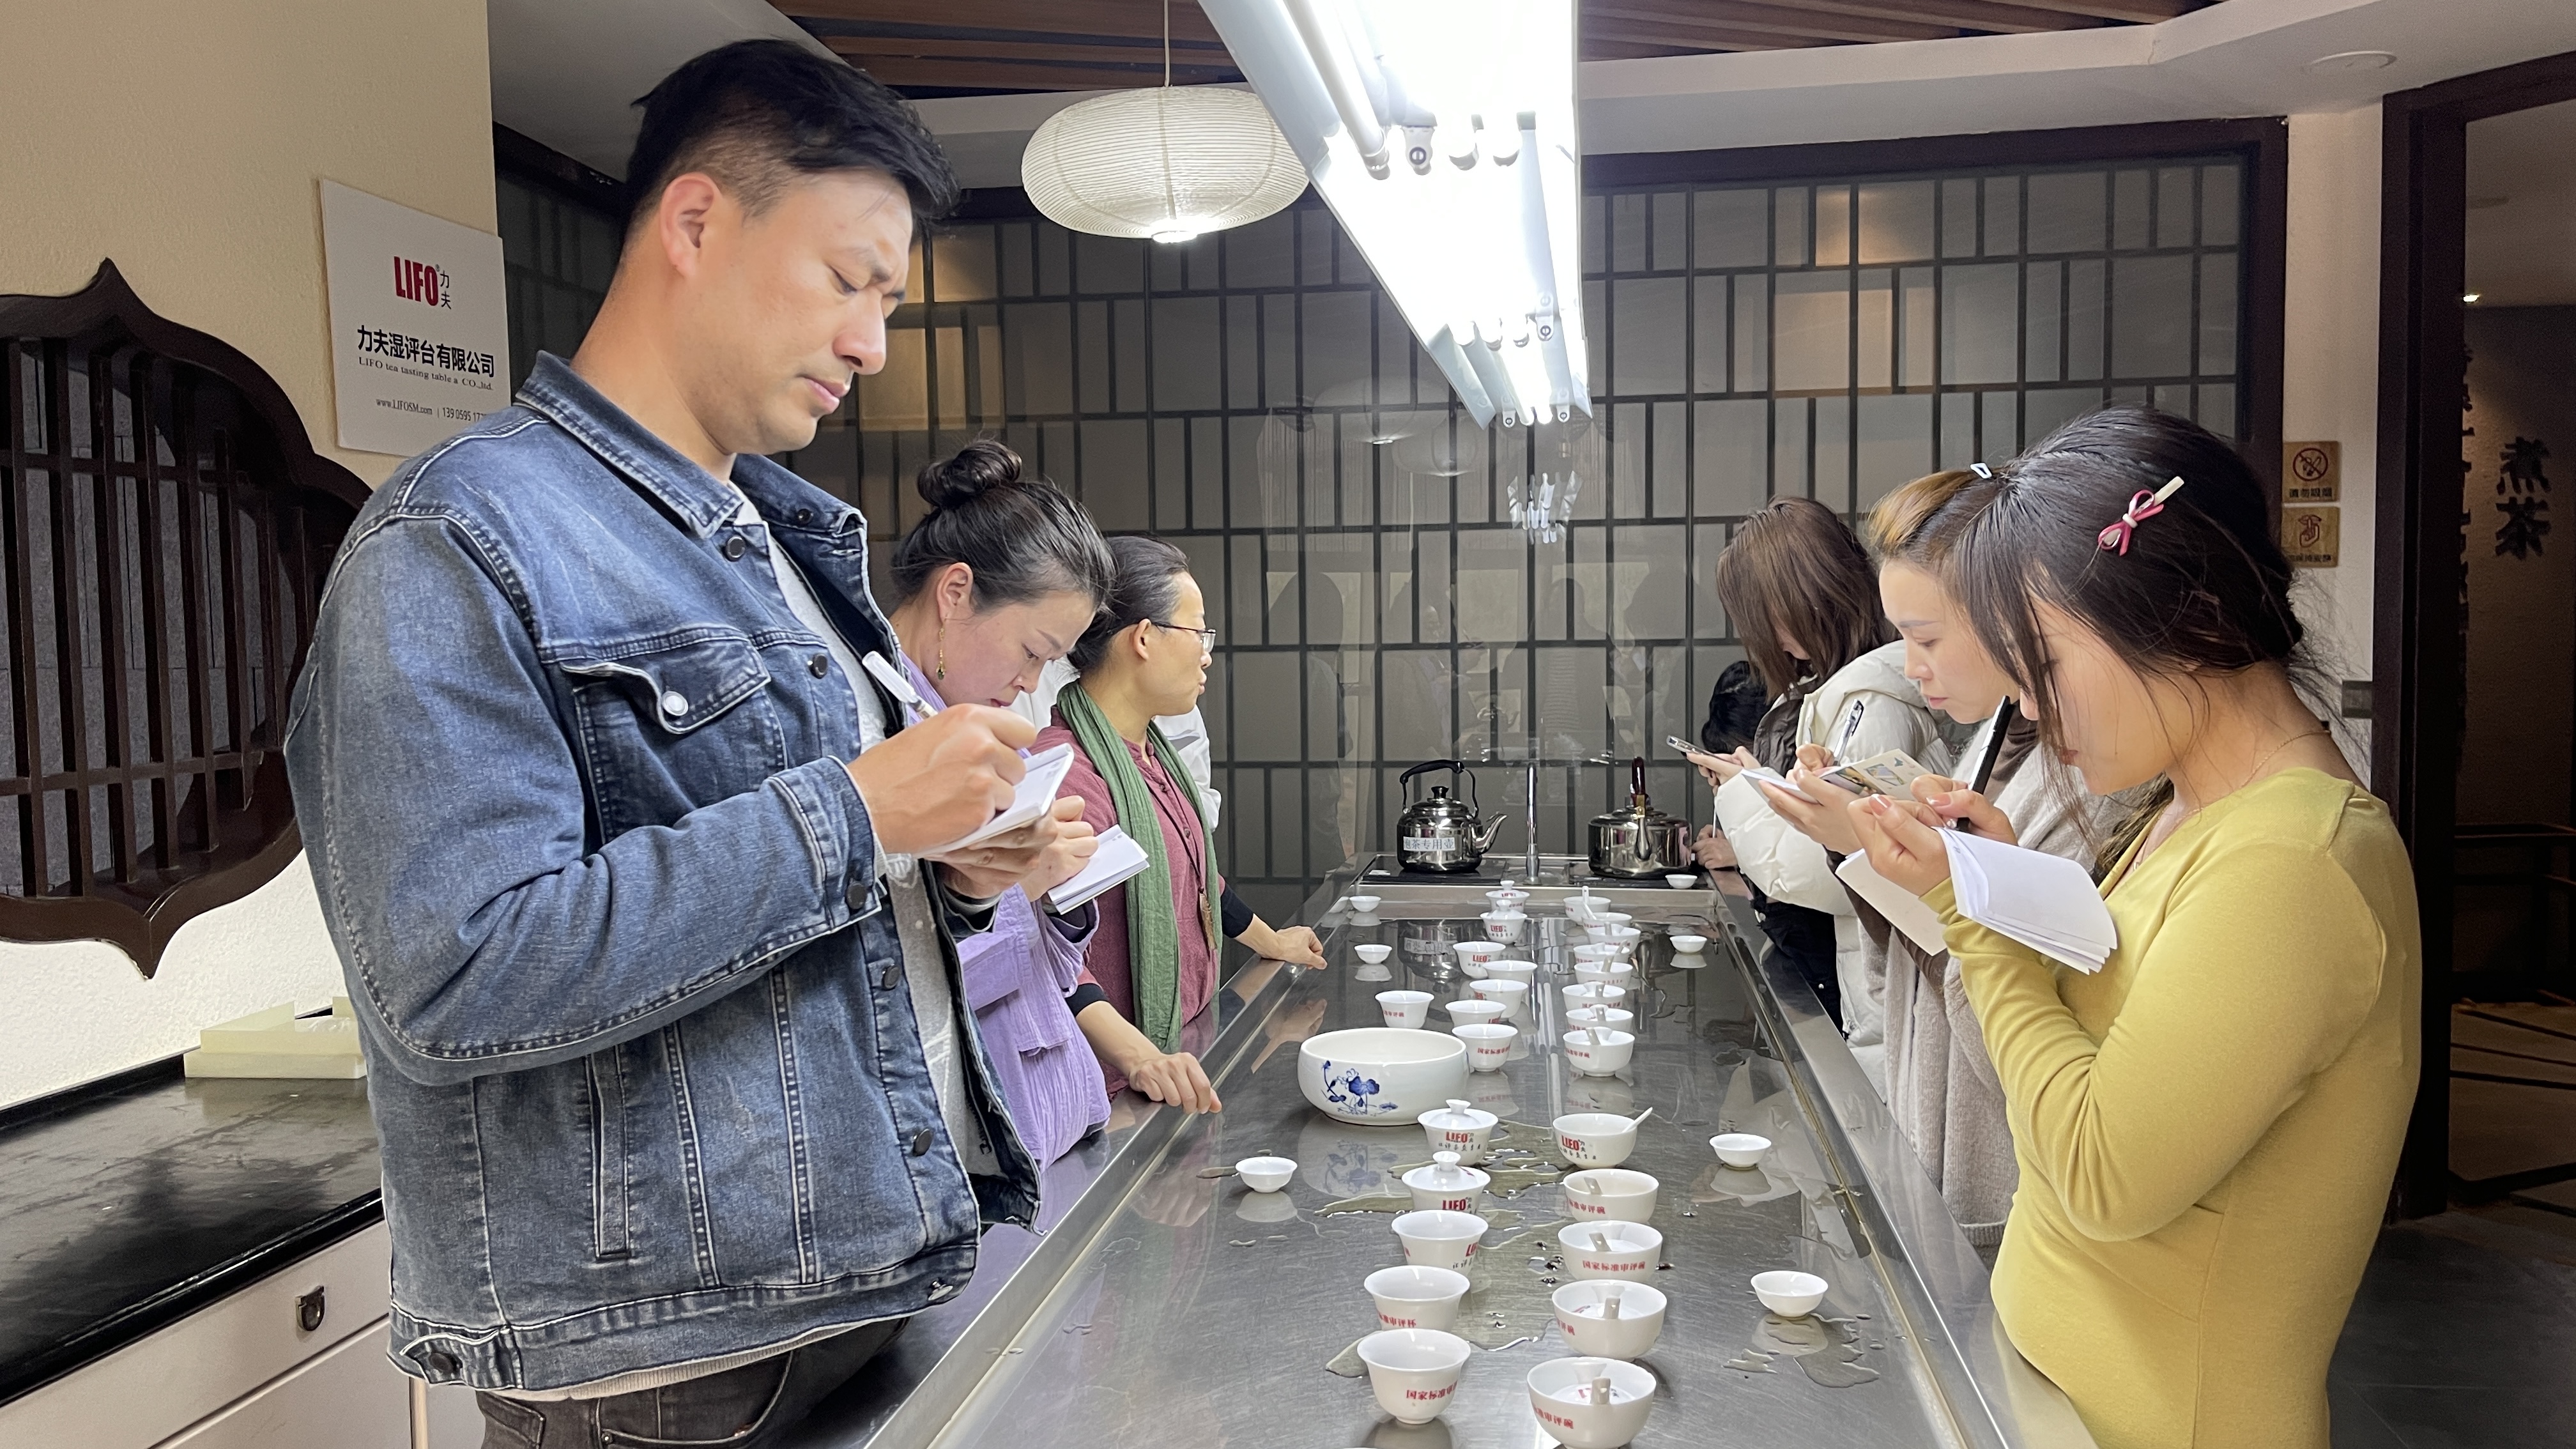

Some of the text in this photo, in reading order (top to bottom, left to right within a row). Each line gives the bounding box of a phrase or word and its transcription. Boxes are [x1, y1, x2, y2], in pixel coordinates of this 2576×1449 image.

[394, 256, 438, 306] LIFO
[440, 270, 452, 310] 力夫
[357, 325, 494, 378] 力夫湿评台有限公司
[359, 356, 383, 369] LIFO
[386, 363, 398, 372] tea
[401, 366, 429, 380] tasting
[431, 372, 451, 383] table
[443, 407, 454, 418] 139
[1404, 838, 1455, 850] 泡茶专用壶
[1473, 954, 1487, 963] LIFO
[1446, 1131, 1468, 1144] LIFO
[1561, 1135, 1579, 1151] LIFO
[1442, 1199, 1466, 1211] LIFO
